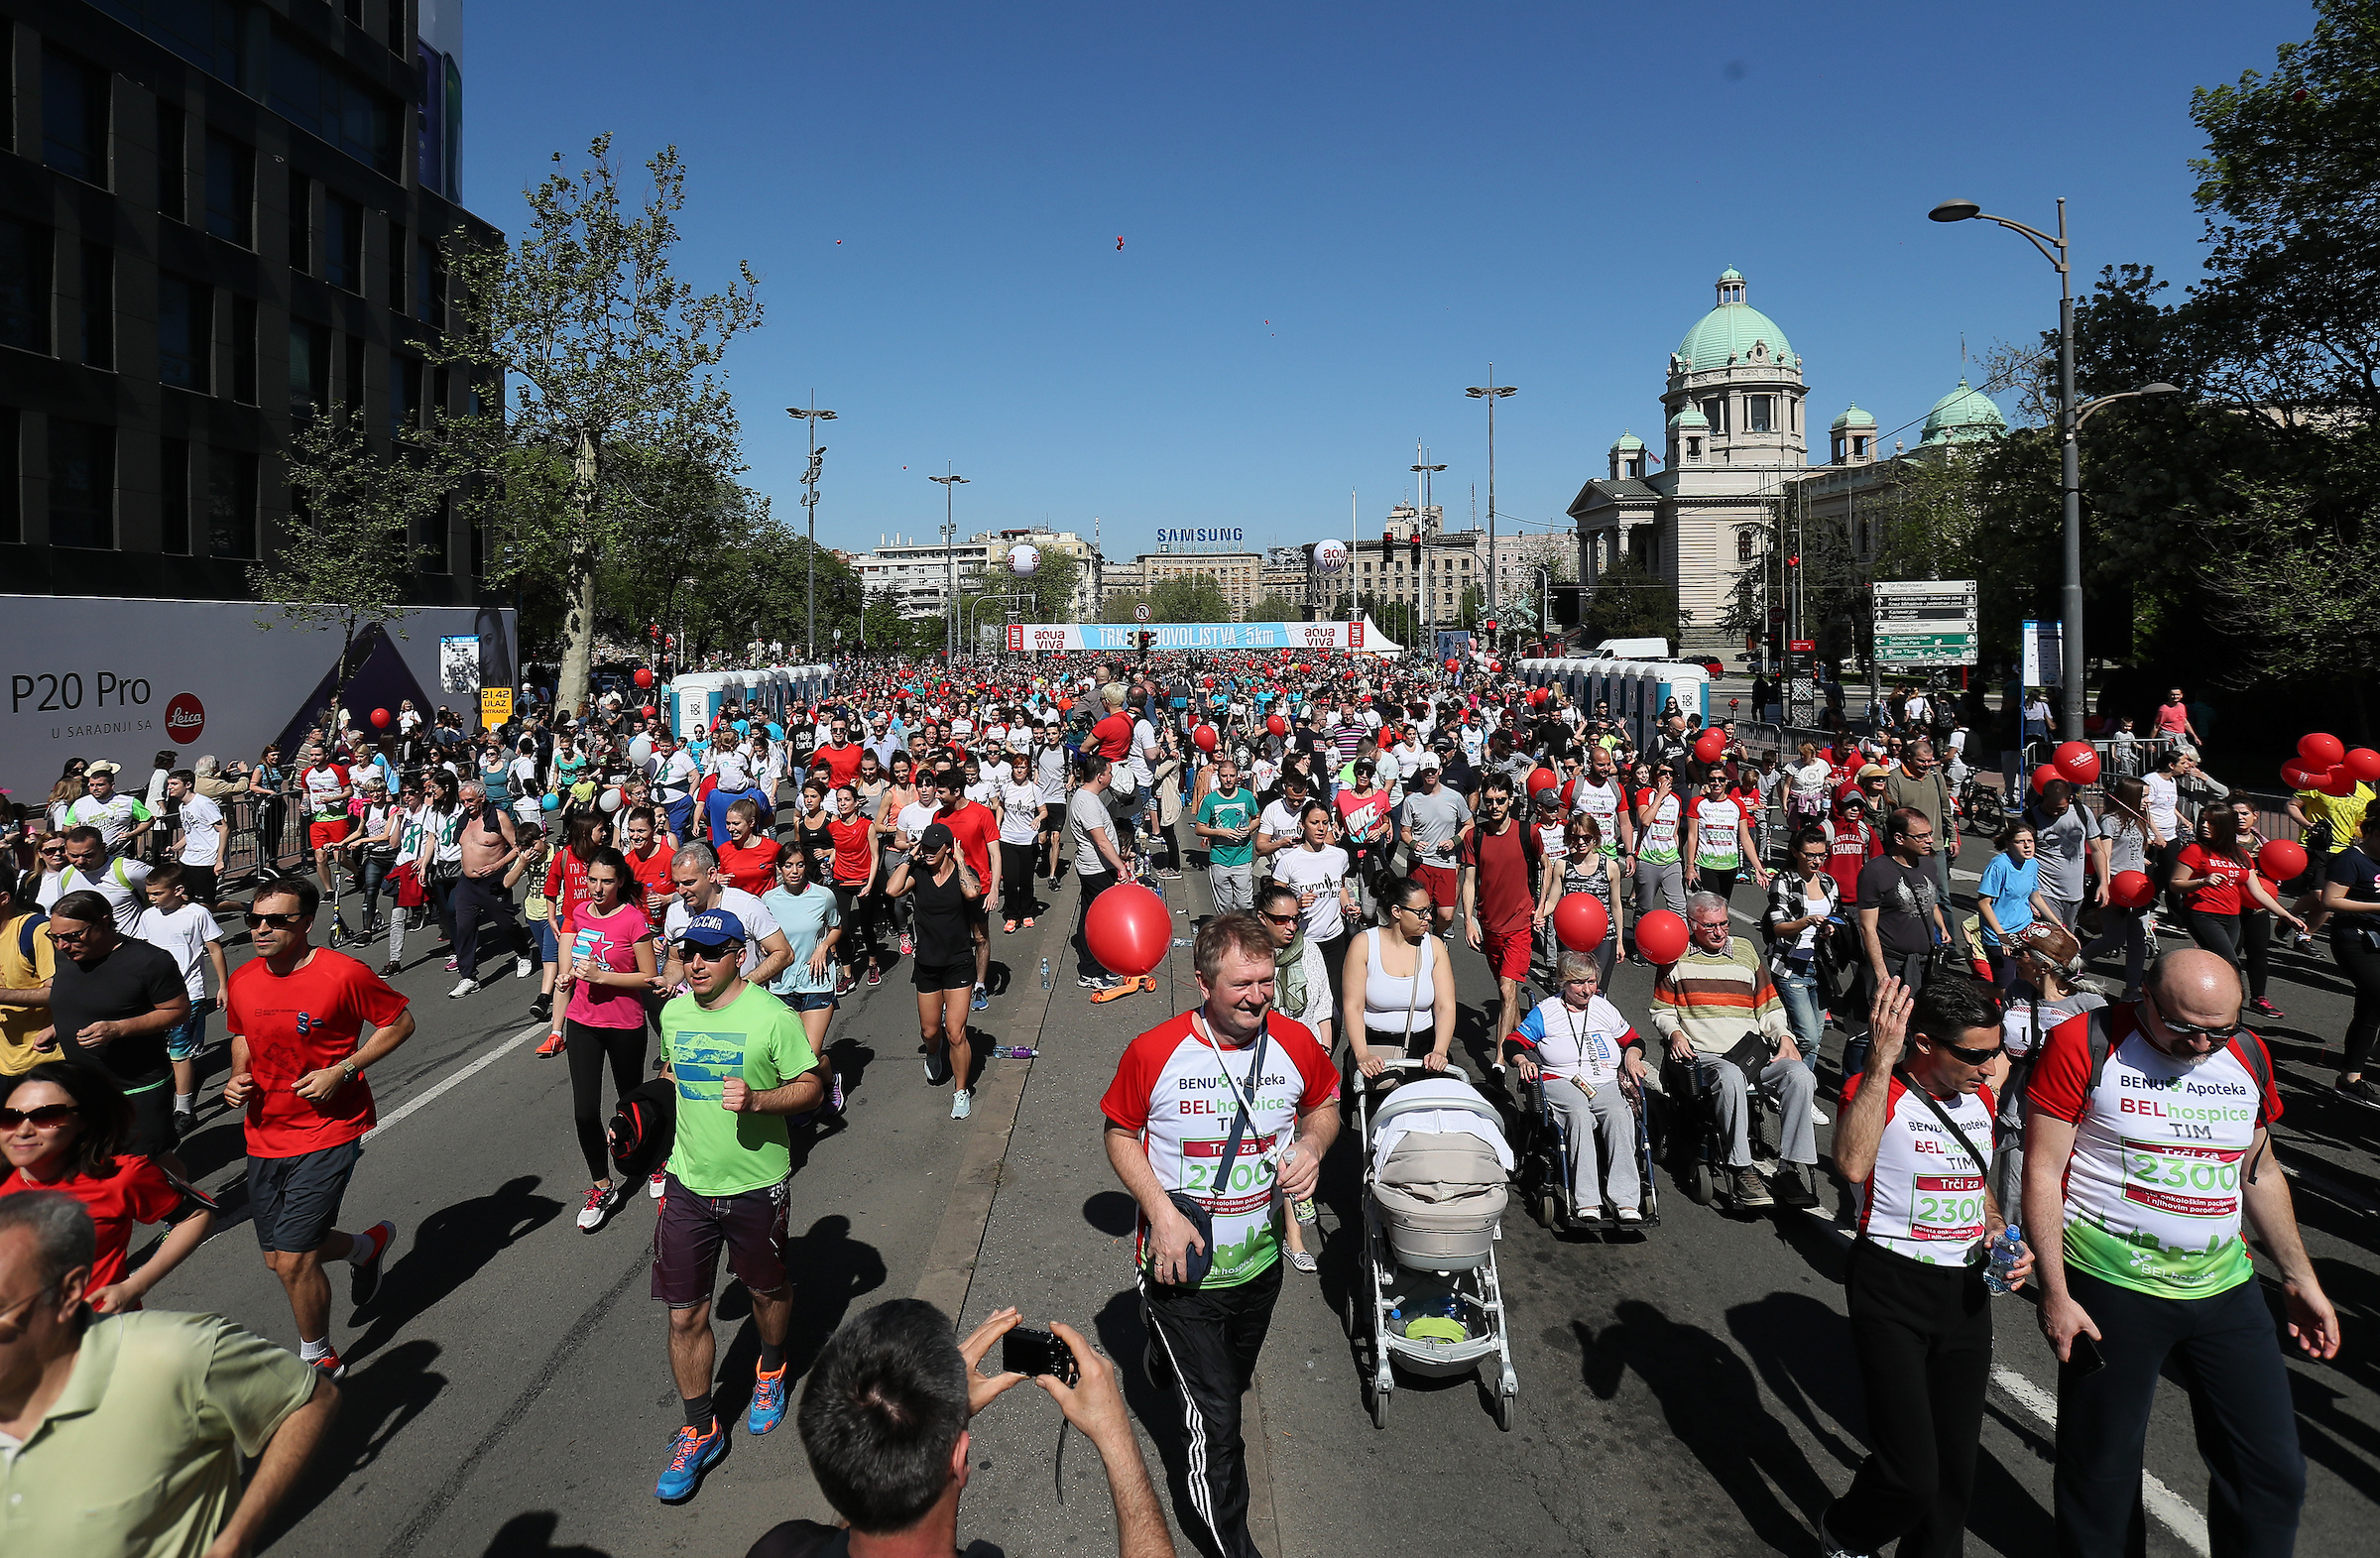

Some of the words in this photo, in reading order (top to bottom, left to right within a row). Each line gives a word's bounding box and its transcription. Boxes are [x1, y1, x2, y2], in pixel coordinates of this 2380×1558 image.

[1157, 528, 1243, 541] SAMSUNG
[1012, 627, 1021, 649] START
[1246, 627, 1274, 645] 5km
[1307, 637, 1334, 647] viva
[1351, 624, 1362, 646] START
[1036, 640, 1064, 649] viva
[12, 671, 83, 714] P20
[97, 670, 151, 708] Pro
[168, 706, 203, 728] Leica
[52, 728, 60, 739] U
[67, 722, 132, 738] SARADNJI
[137, 720, 153, 731] SA
[1345, 801, 1376, 836] NIKE
[1708, 830, 1732, 840] 2300
[1833, 843, 1863, 855] CHAMPION
[1179, 1077, 1217, 1090] BENU
[1236, 1073, 1285, 1087] Ateka
[2120, 1075, 2164, 1091] BENU
[2186, 1082, 2246, 1097] Apoteka
[2120, 1097, 2249, 1124] BELhospice
[1908, 1122, 1942, 1134] BENU
[1960, 1118, 1987, 1132] poteka
[2169, 1123, 2212, 1139] TIM
[1210, 1142, 1226, 1155] Tr
[1241, 1143, 1257, 1154] za
[2162, 1147, 2197, 1157] Trči
[2201, 1151, 2220, 1160] za
[1946, 1156, 1975, 1170] TIM
[1187, 1158, 1272, 1191] 200
[2133, 1153, 2237, 1191] 2300
[1941, 1178, 1964, 1190] Trči
[1966, 1180, 1979, 1189] za
[2152, 1198, 2189, 1212] njihovim
[2160, 1194, 2206, 1206] onkološkim
